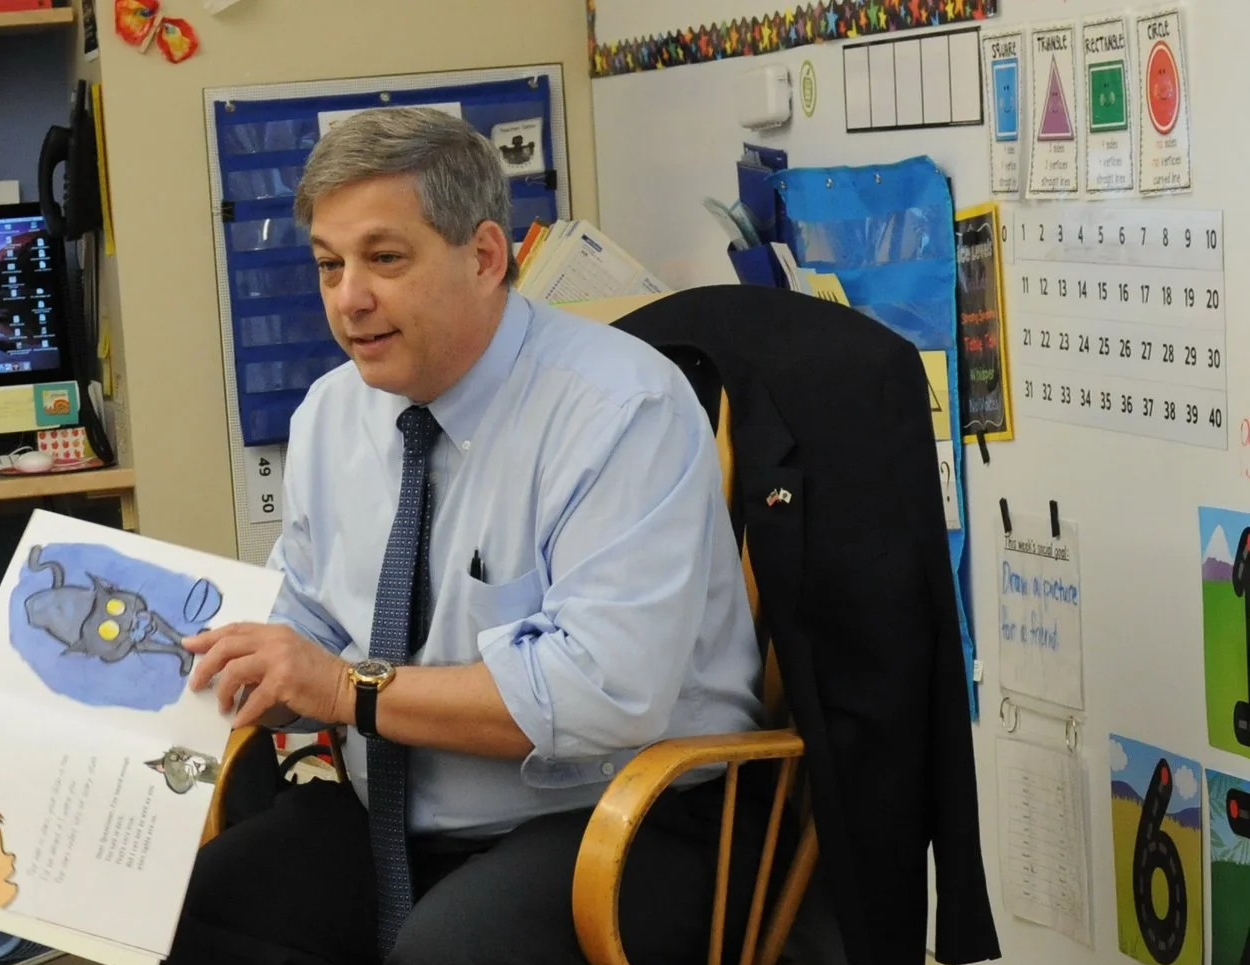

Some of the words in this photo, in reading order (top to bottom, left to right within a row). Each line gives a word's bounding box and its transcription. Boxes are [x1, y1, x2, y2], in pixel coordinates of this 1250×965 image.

[1022, 224, 1025, 240] 1
[1039, 224, 1045, 241] 2
[1058, 225, 1063, 242] 3
[1078, 226, 1084, 244] 4
[1098, 226, 1104, 244] 5
[1119, 227, 1125, 244] 6
[1141, 227, 1147, 245] 7
[1162, 228, 1169, 246] 8
[1185, 229, 1191, 248] 9
[1206, 229, 1217, 249] 10
[1022, 277, 1029, 294] 11
[1039, 278, 1048, 295] 12
[1058, 279, 1067, 297] 13
[1078, 281, 1087, 299] 14
[1098, 282, 1108, 300] 15
[1119, 283, 1129, 302] 16
[1141, 285, 1150, 303] 17
[1162, 286, 1172, 305] 18
[1184, 288, 1195, 307] 19
[1206, 290, 1219, 309] 20
[1023, 329, 1031, 346] 21
[1041, 331, 1050, 348] 22
[1059, 333, 1069, 350] 23
[1079, 335, 1089, 353] 24
[1099, 337, 1110, 355] 25
[1120, 339, 1131, 358] 26
[1141, 342, 1152, 360] 27
[1163, 344, 1174, 363] 28
[1185, 346, 1197, 366] 29
[1207, 349, 1220, 368] 30
[1025, 381, 1033, 398] 31
[1042, 384, 1052, 401] 32
[1061, 386, 1071, 404] 33
[1080, 389, 1091, 408] 34
[1100, 392, 1111, 410] 35
[1121, 395, 1133, 414] 36
[1143, 398, 1154, 416] 37
[1164, 401, 1176, 420] 38
[1186, 404, 1198, 424] 39
[1209, 408, 1222, 428] 40
[258, 456, 272, 477] 49
[261, 493, 275, 513] 50
[1002, 560, 1027, 596] Draw
[1043, 577, 1078, 611] picture
[1133, 757, 1187, 965] 6
